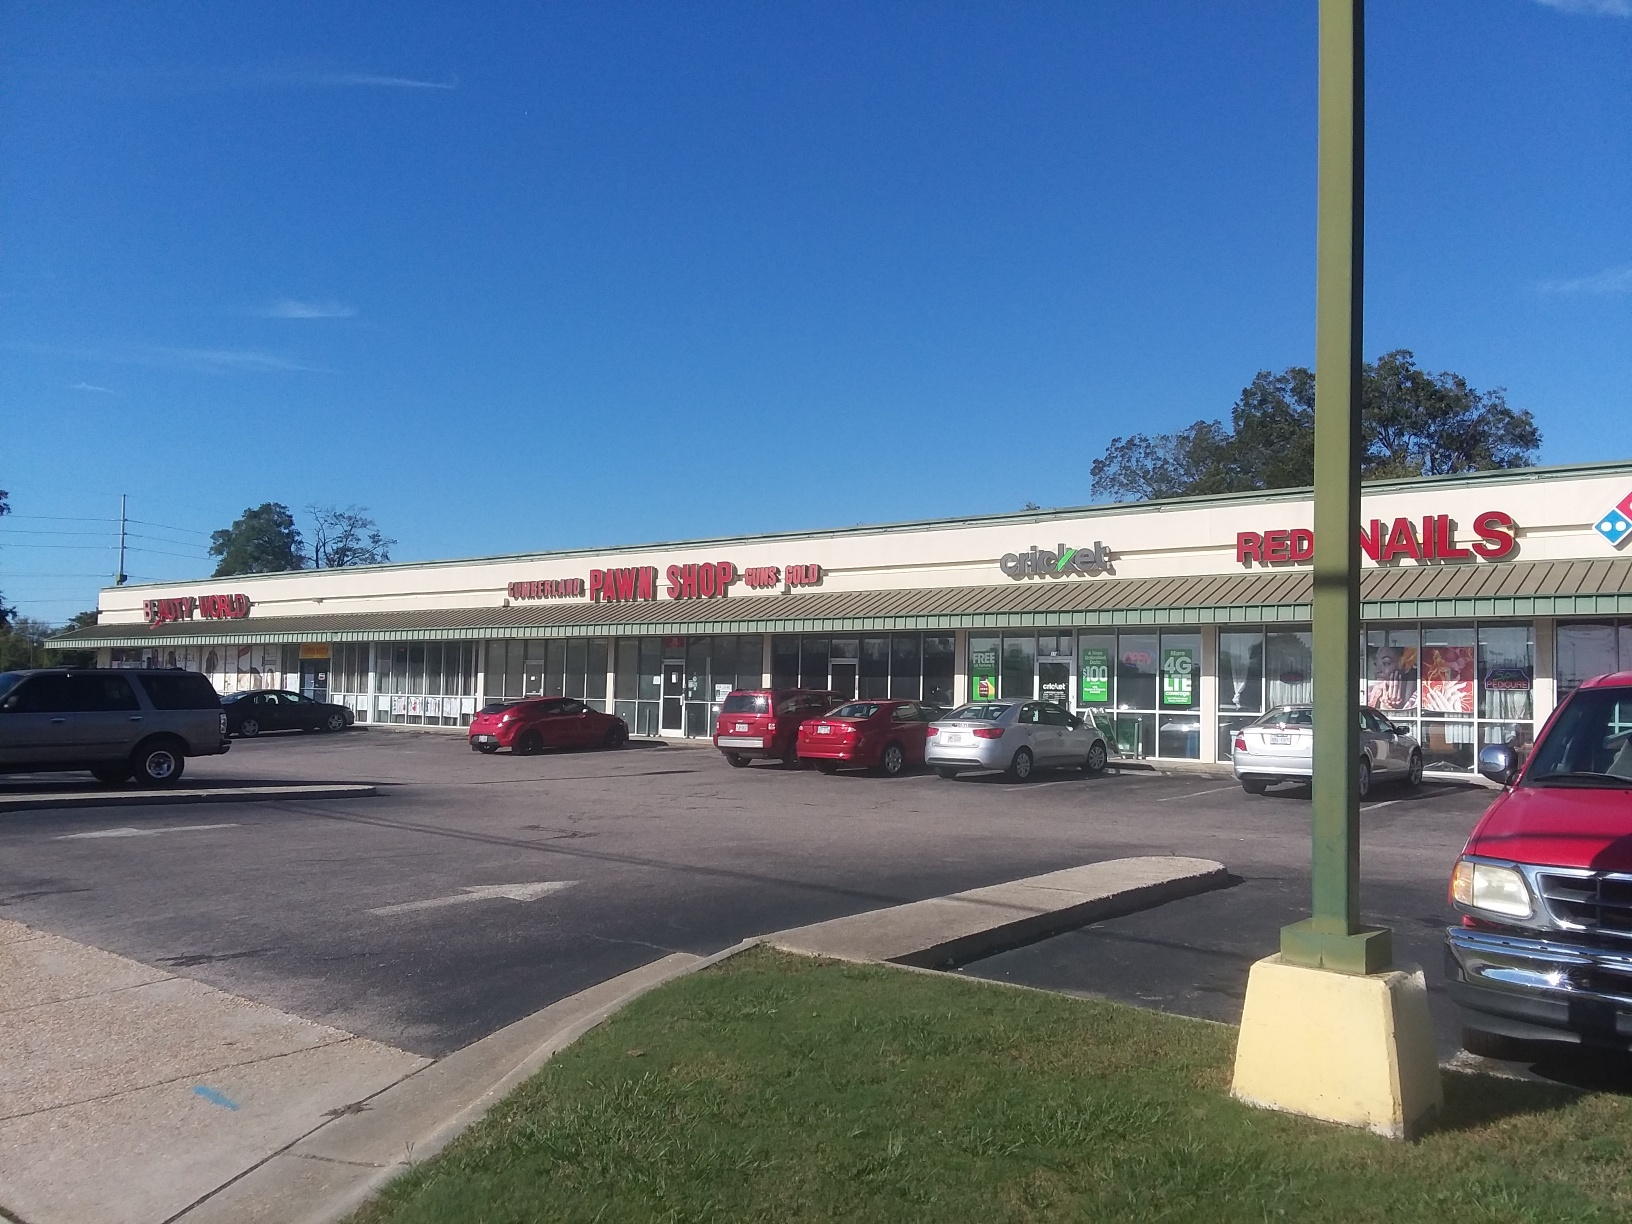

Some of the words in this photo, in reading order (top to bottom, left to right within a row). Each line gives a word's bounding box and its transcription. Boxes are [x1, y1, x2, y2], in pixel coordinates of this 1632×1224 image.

[1236, 529, 1314, 562] RED
[1000, 541, 1106, 575] cricket
[508, 578, 581, 598] CUMBERLAND
[590, 565, 654, 601] PAWN
[666, 561, 732, 599] SHOP
[745, 566, 777, 586] GUNS
[785, 563, 818, 585] GOLD
[143, 597, 195, 628] BEAUTY
[198, 594, 246, 618] WORLD
[973, 653, 995, 663] FREE
[1124, 652, 1152, 665] OPEN
[1164, 657, 1191, 674] 4G
[1083, 666, 1108, 682] $100
[1164, 674, 1191, 691] LTE
[1486, 681, 1528, 689] PEDICURE
